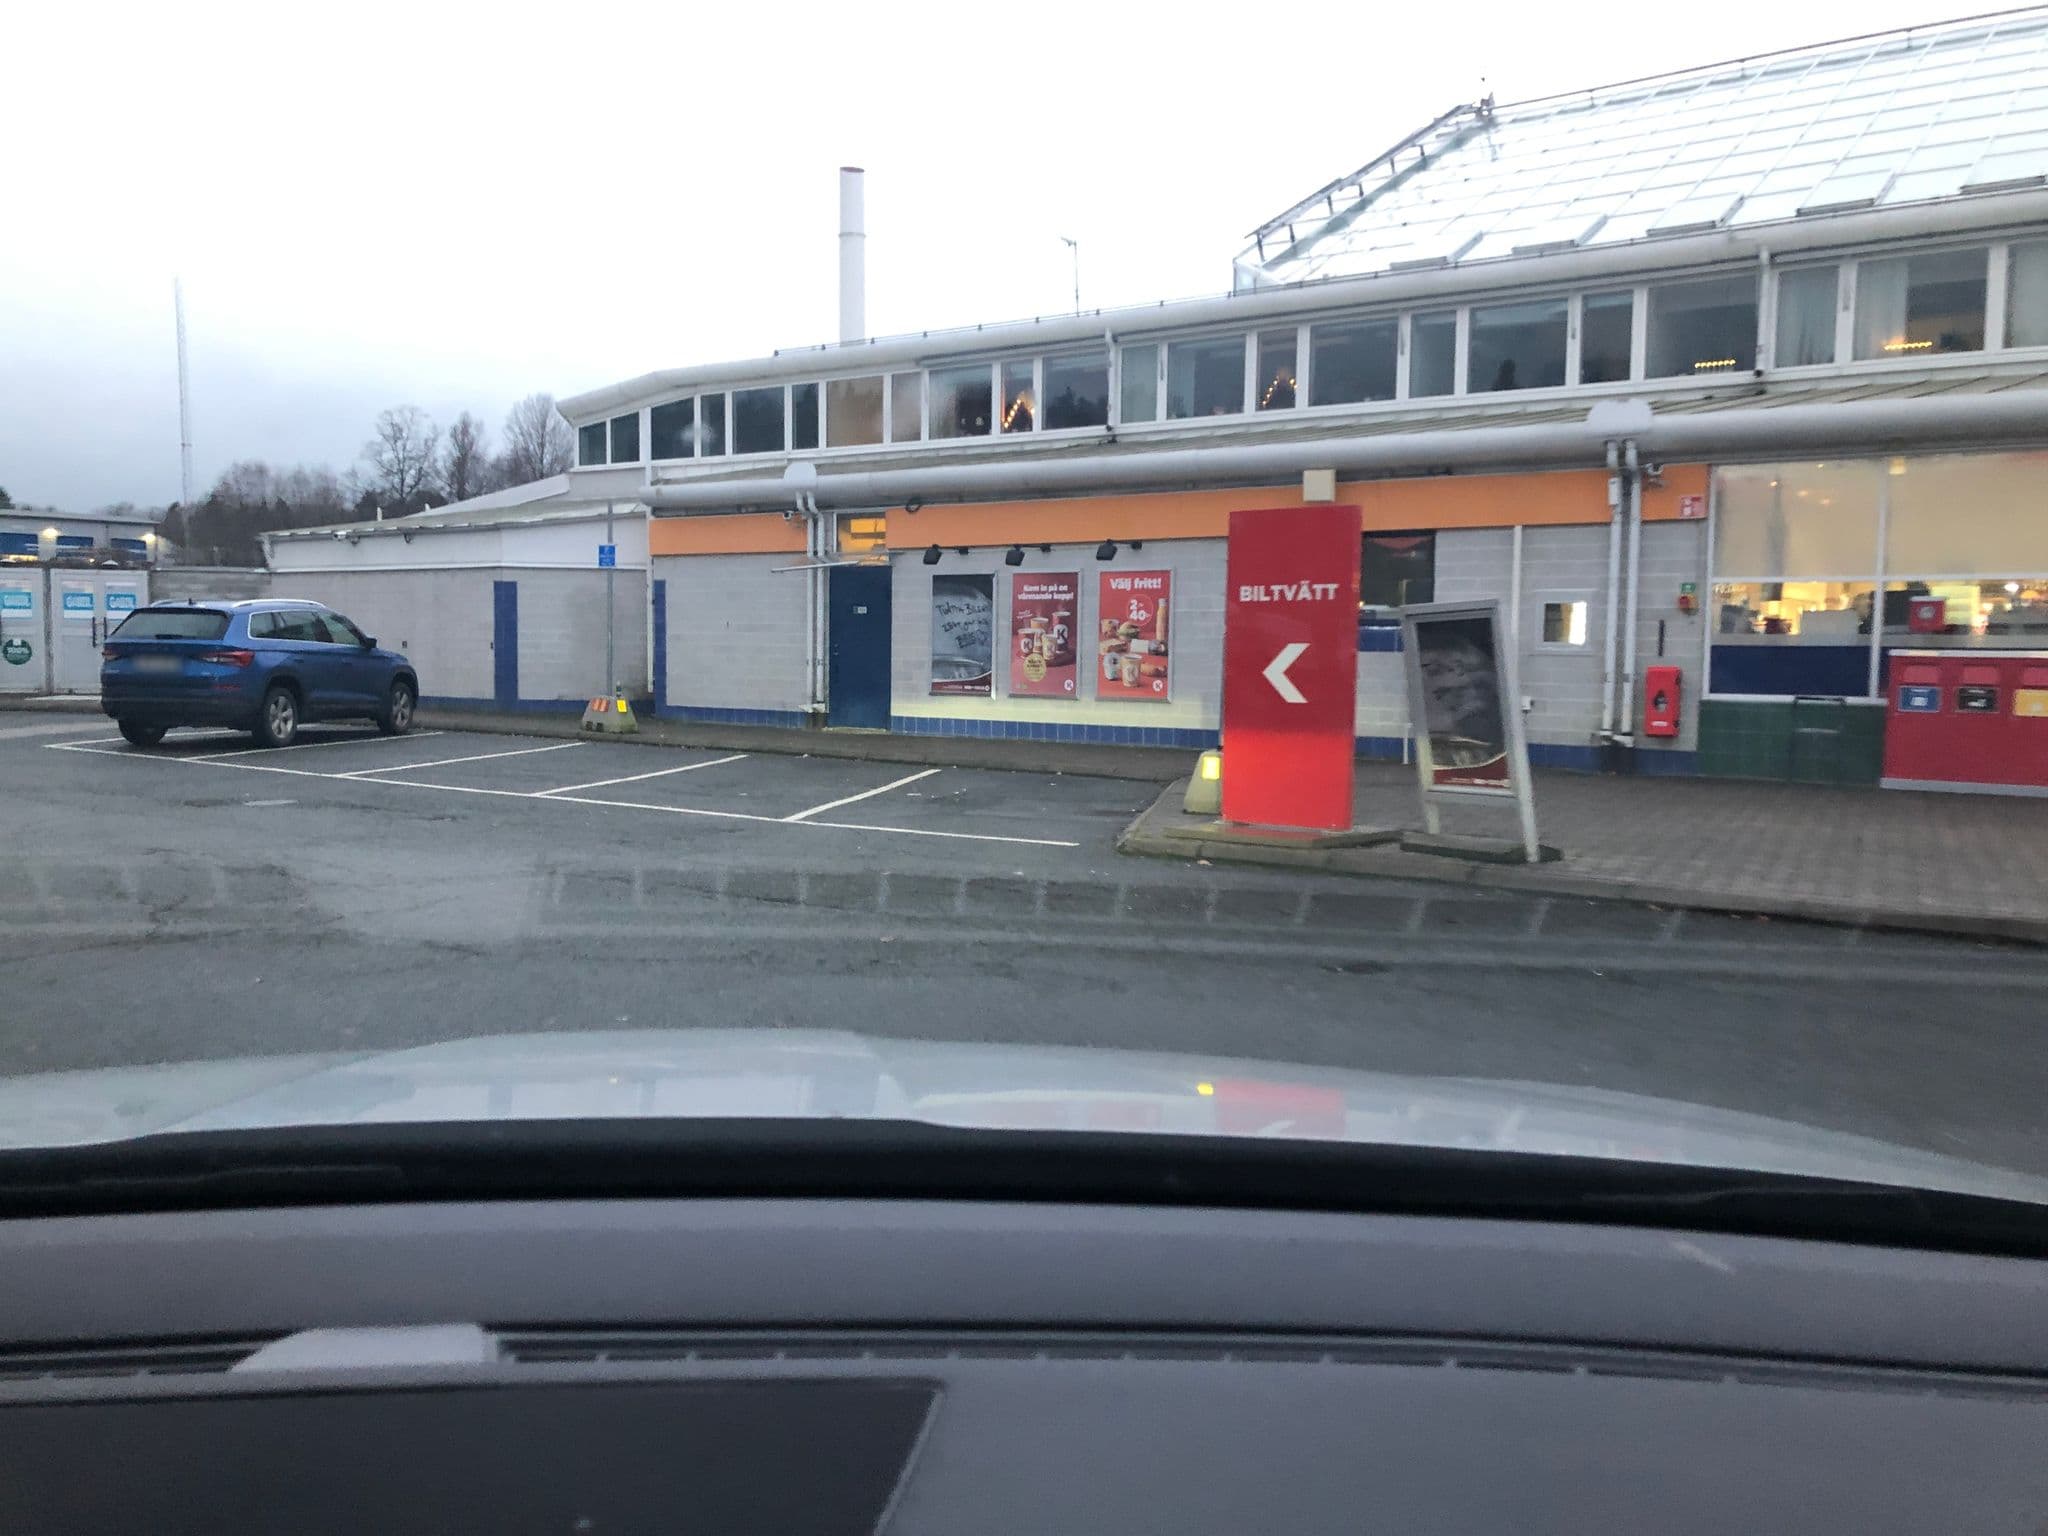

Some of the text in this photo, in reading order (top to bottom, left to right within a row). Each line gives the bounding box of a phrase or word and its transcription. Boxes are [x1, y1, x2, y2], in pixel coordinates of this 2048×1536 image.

[1109, 577, 1162, 591] Välj fritt!
[1239, 580, 1340, 602] BILTVÄTT
